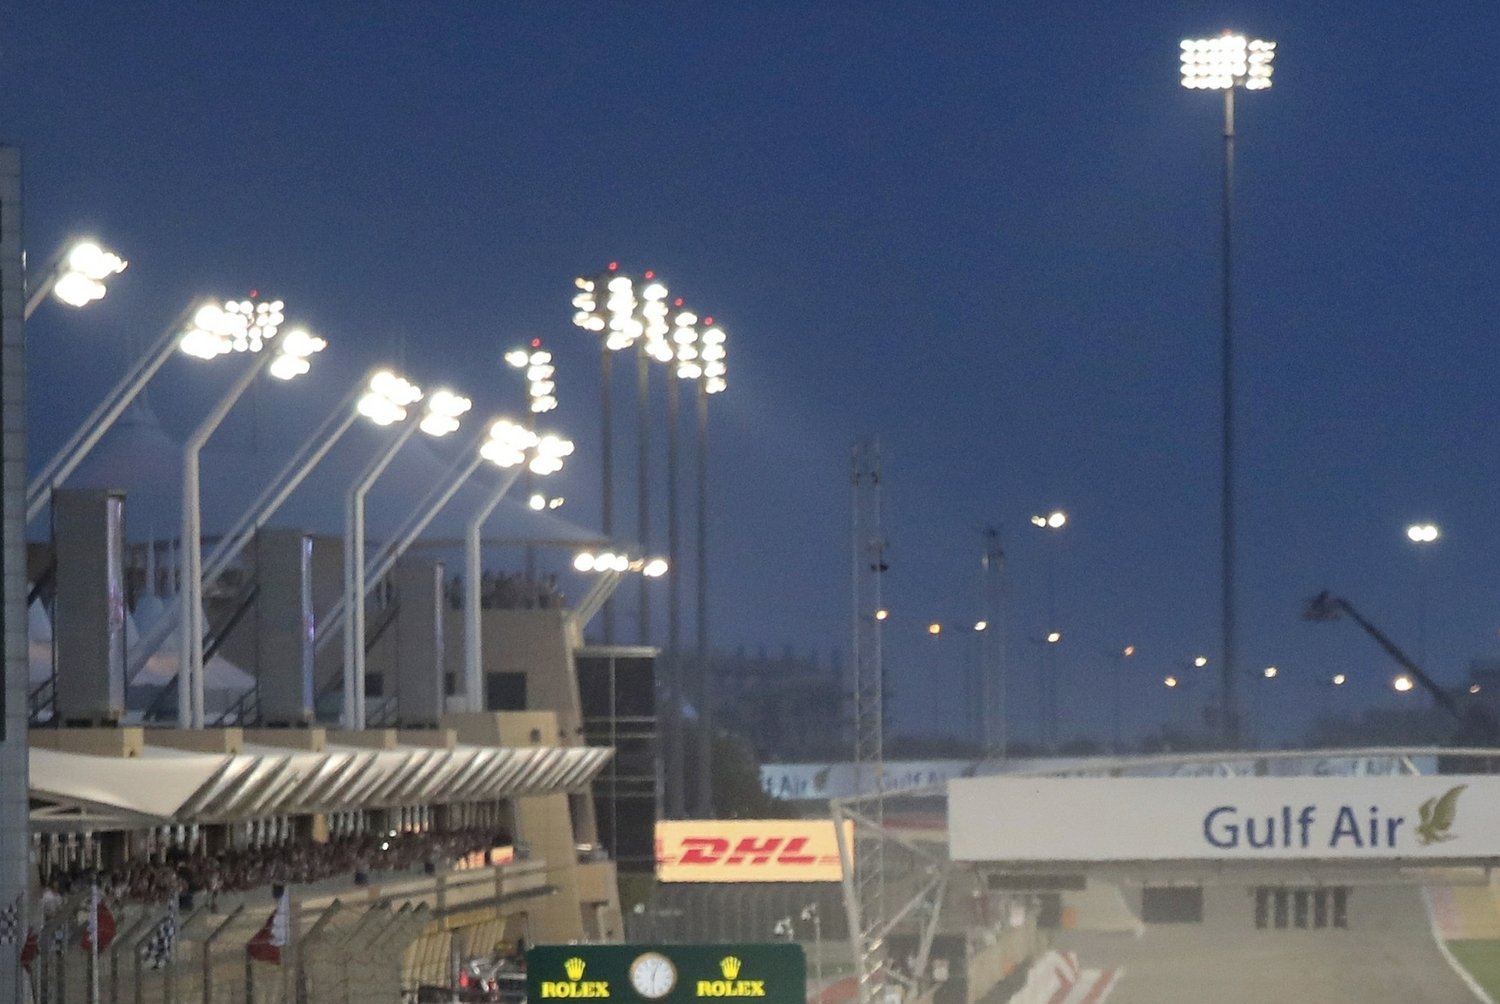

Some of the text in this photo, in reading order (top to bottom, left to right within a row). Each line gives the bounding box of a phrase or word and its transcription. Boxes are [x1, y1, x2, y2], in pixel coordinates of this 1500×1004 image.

[1203, 804, 1404, 849] Gulf Air
[678, 837, 816, 865] DHL
[541, 981, 610, 998] ROLEX
[696, 980, 766, 997] ROLEX
